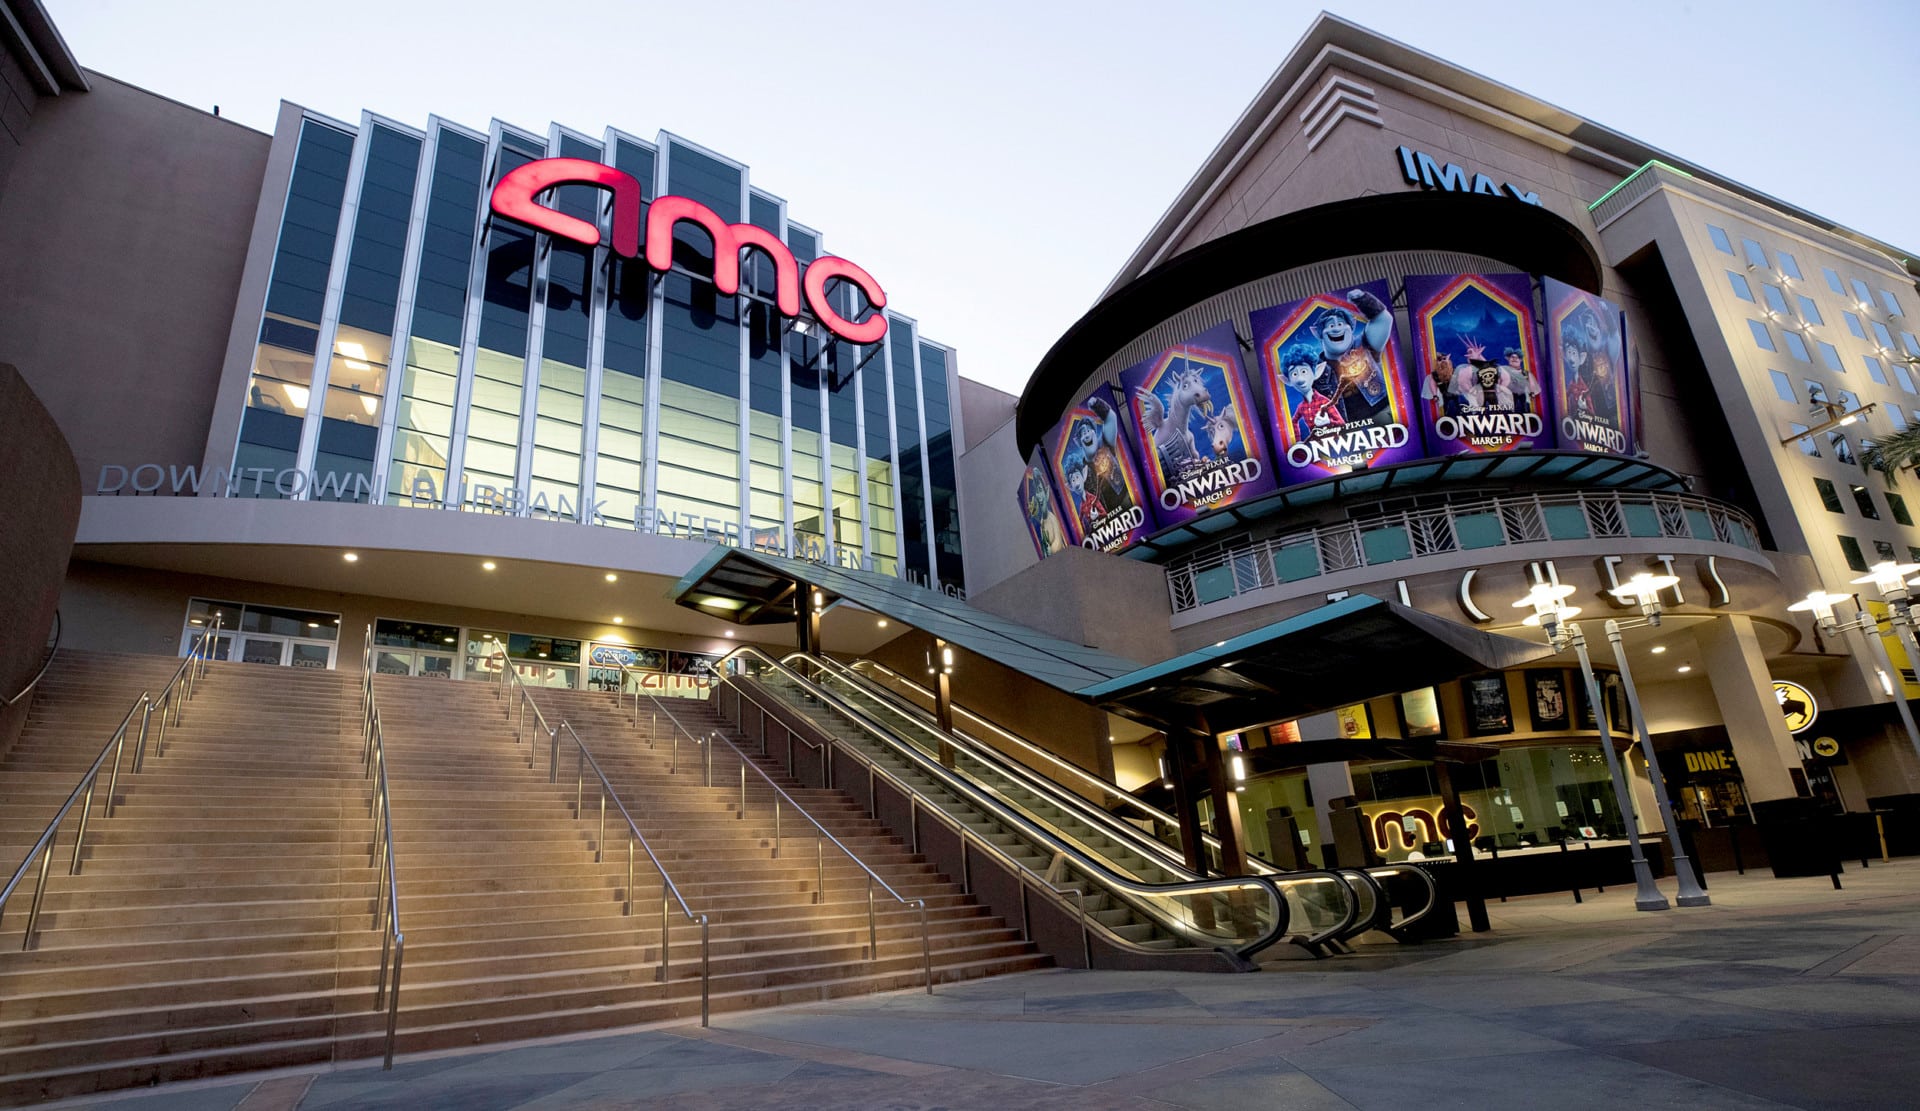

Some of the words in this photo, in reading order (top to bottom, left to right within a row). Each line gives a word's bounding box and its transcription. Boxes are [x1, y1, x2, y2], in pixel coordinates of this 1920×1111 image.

[1488, 404, 1514, 412] PIXAR
[1312, 426, 1341, 438] Disney
[1345, 418, 1374, 430] PIXAR
[1436, 413, 1543, 440] ONWARD
[1594, 415, 1610, 425] PIXAR
[1471, 436, 1503, 447] MARCH
[1505, 436, 1513, 444] 6
[1562, 416, 1626, 454] ONWARD
[1287, 423, 1409, 468] ONWARD
[1583, 442, 1603, 453] MARCH
[1206, 456, 1231, 470] PIXAR
[1327, 455, 1361, 468] MARCH
[1366, 450, 1374, 459] 6
[1160, 458, 1261, 511] ONWARD
[1193, 491, 1223, 507] MARCH
[1225, 488, 1233, 496] 6
[96, 463, 383, 499] DOWNTOWN
[411, 476, 608, 525] BURBANK
[633, 504, 880, 570] ENTERTAINMENT
[1107, 506, 1122, 519] PIXAR
[1082, 506, 1144, 550] ONWARD
[1103, 537, 1122, 553] MARCH
[1363, 803, 1480, 853] mc
